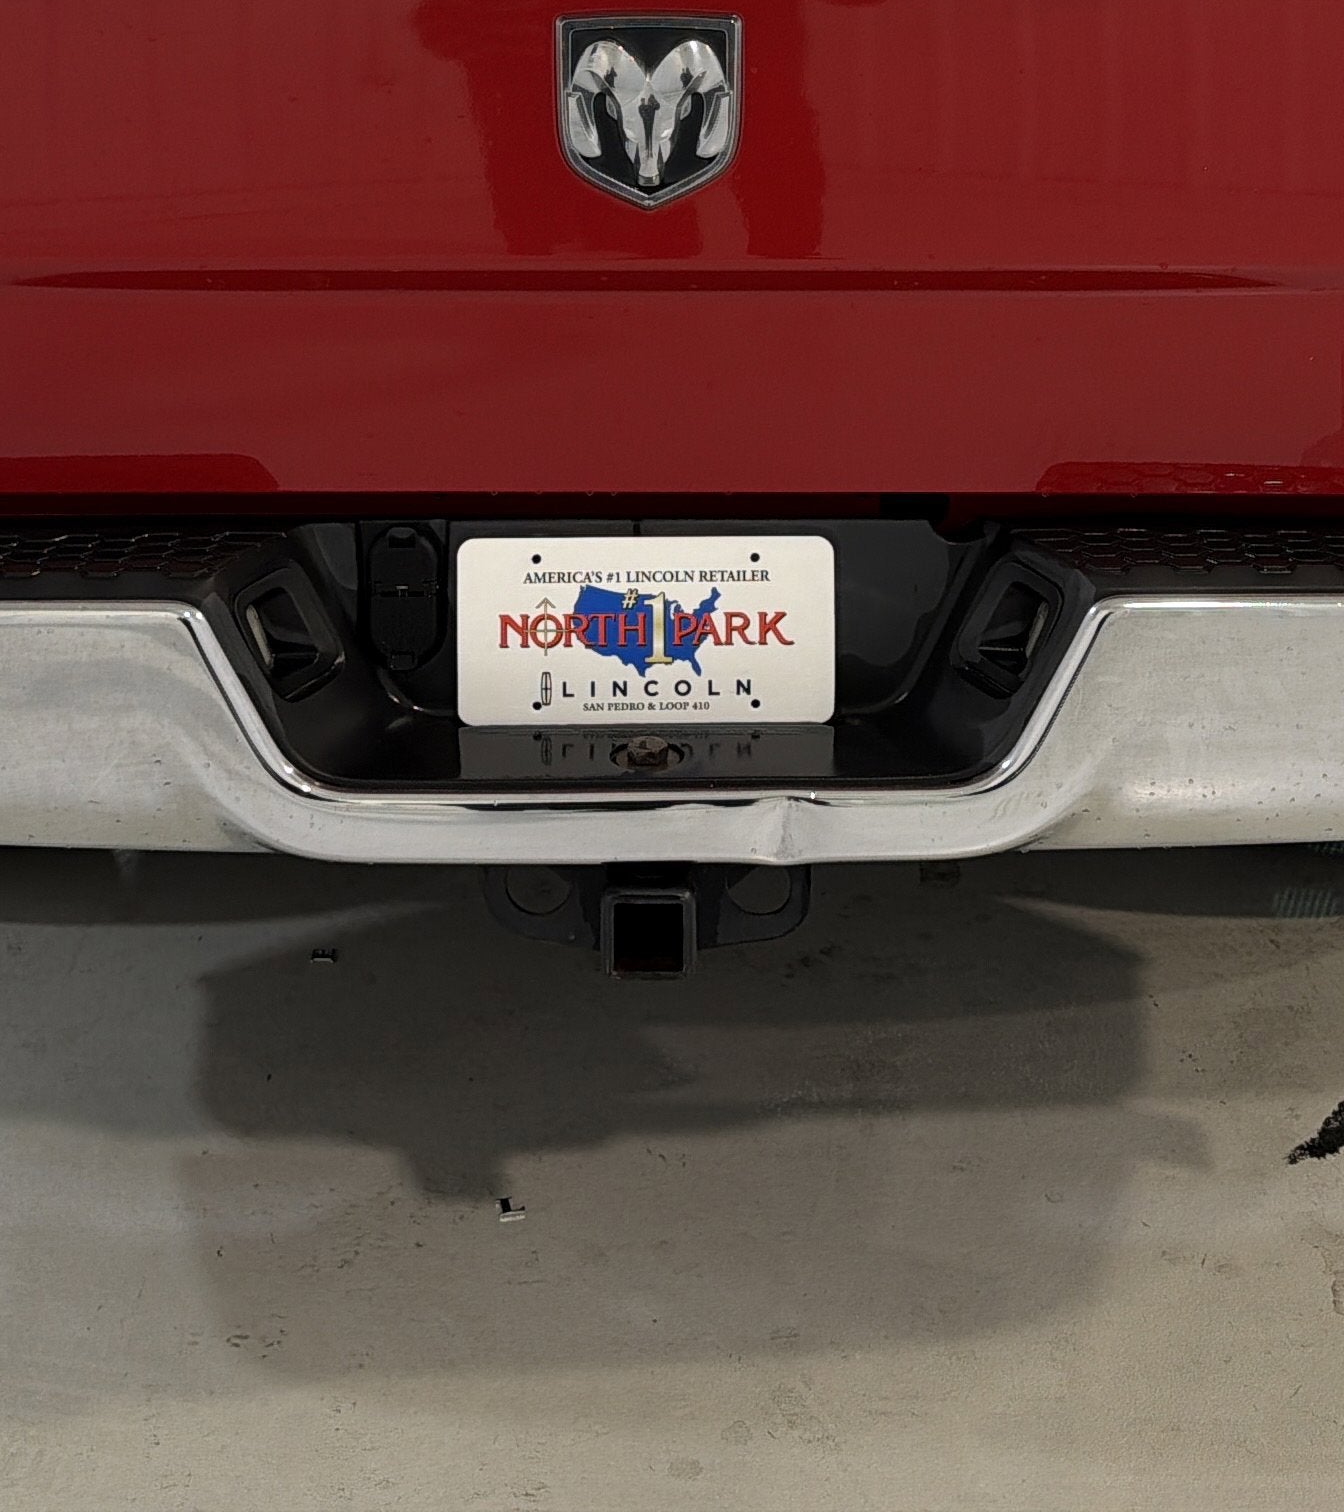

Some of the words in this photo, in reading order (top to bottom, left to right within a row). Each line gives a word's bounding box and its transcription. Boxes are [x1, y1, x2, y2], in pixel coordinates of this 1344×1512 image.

[523, 570, 603, 584] AMERICA'S
[606, 571, 623, 584] #1
[626, 569, 695, 583] LINCOLN
[699, 569, 771, 583] RETAILER
[498, 611, 646, 649] NORTH
[672, 611, 796, 646] PARK
[562, 678, 752, 698] LINCOLN
[582, 702, 605, 712] SAN
[607, 702, 645, 711] PEDRO
[647, 701, 657, 711] &
[659, 701, 690, 711] LOOP
[691, 701, 710, 711] 410
